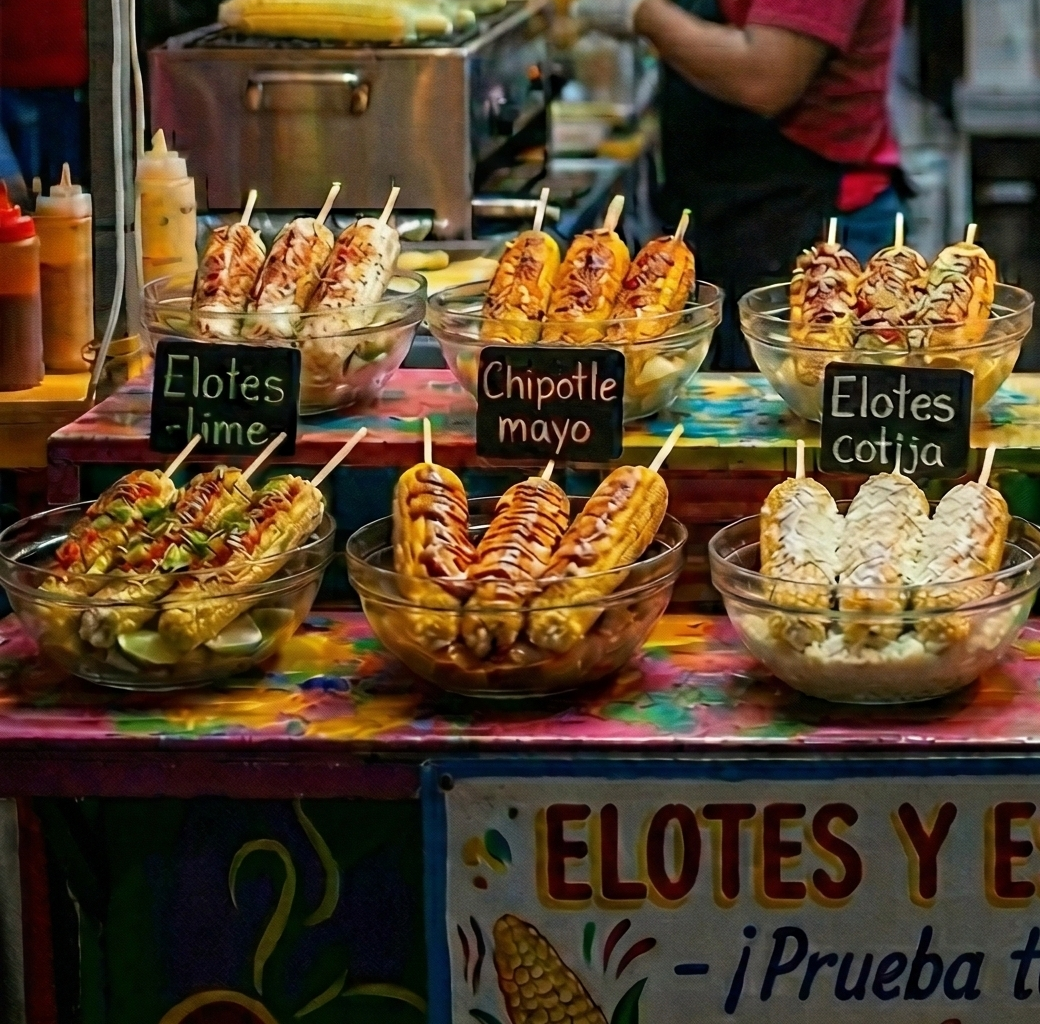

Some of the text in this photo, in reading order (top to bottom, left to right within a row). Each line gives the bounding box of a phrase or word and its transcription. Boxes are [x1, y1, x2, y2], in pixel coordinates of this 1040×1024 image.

[164, 354, 285, 403] Elotes
[483, 360, 618, 409] Chipotle
[831, 374, 956, 423] Elotes
[499, 413, 591, 455] mayo
[832, 426, 945, 474] cotija
[542, 801, 864, 905] ELOTES
[896, 800, 958, 901] Y
